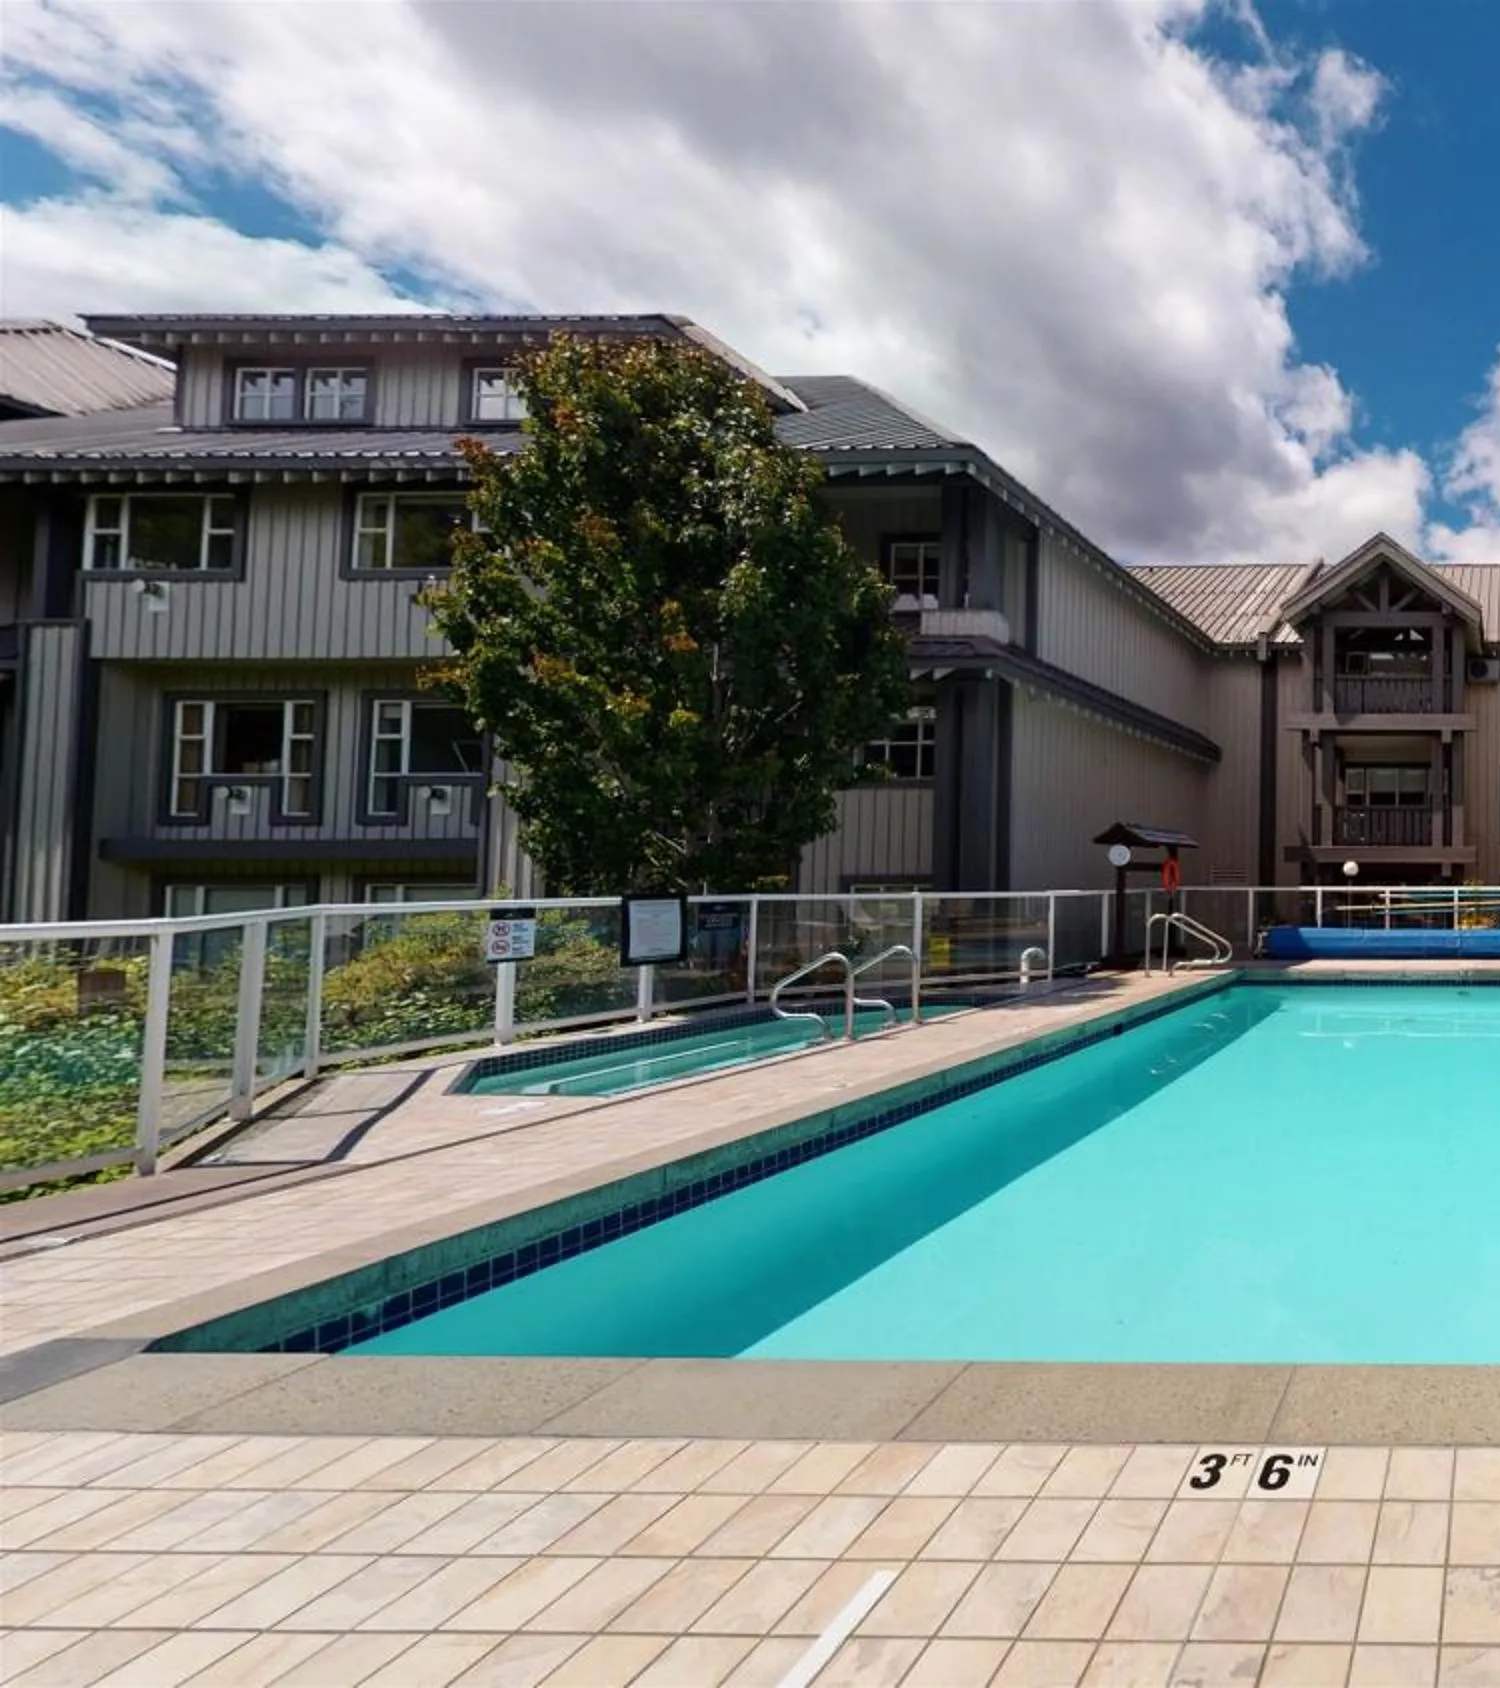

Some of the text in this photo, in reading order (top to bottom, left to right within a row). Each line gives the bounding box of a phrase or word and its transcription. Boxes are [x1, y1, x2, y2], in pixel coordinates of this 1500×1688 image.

[1189, 1453, 1319, 1491] 3 FT 6 IN
